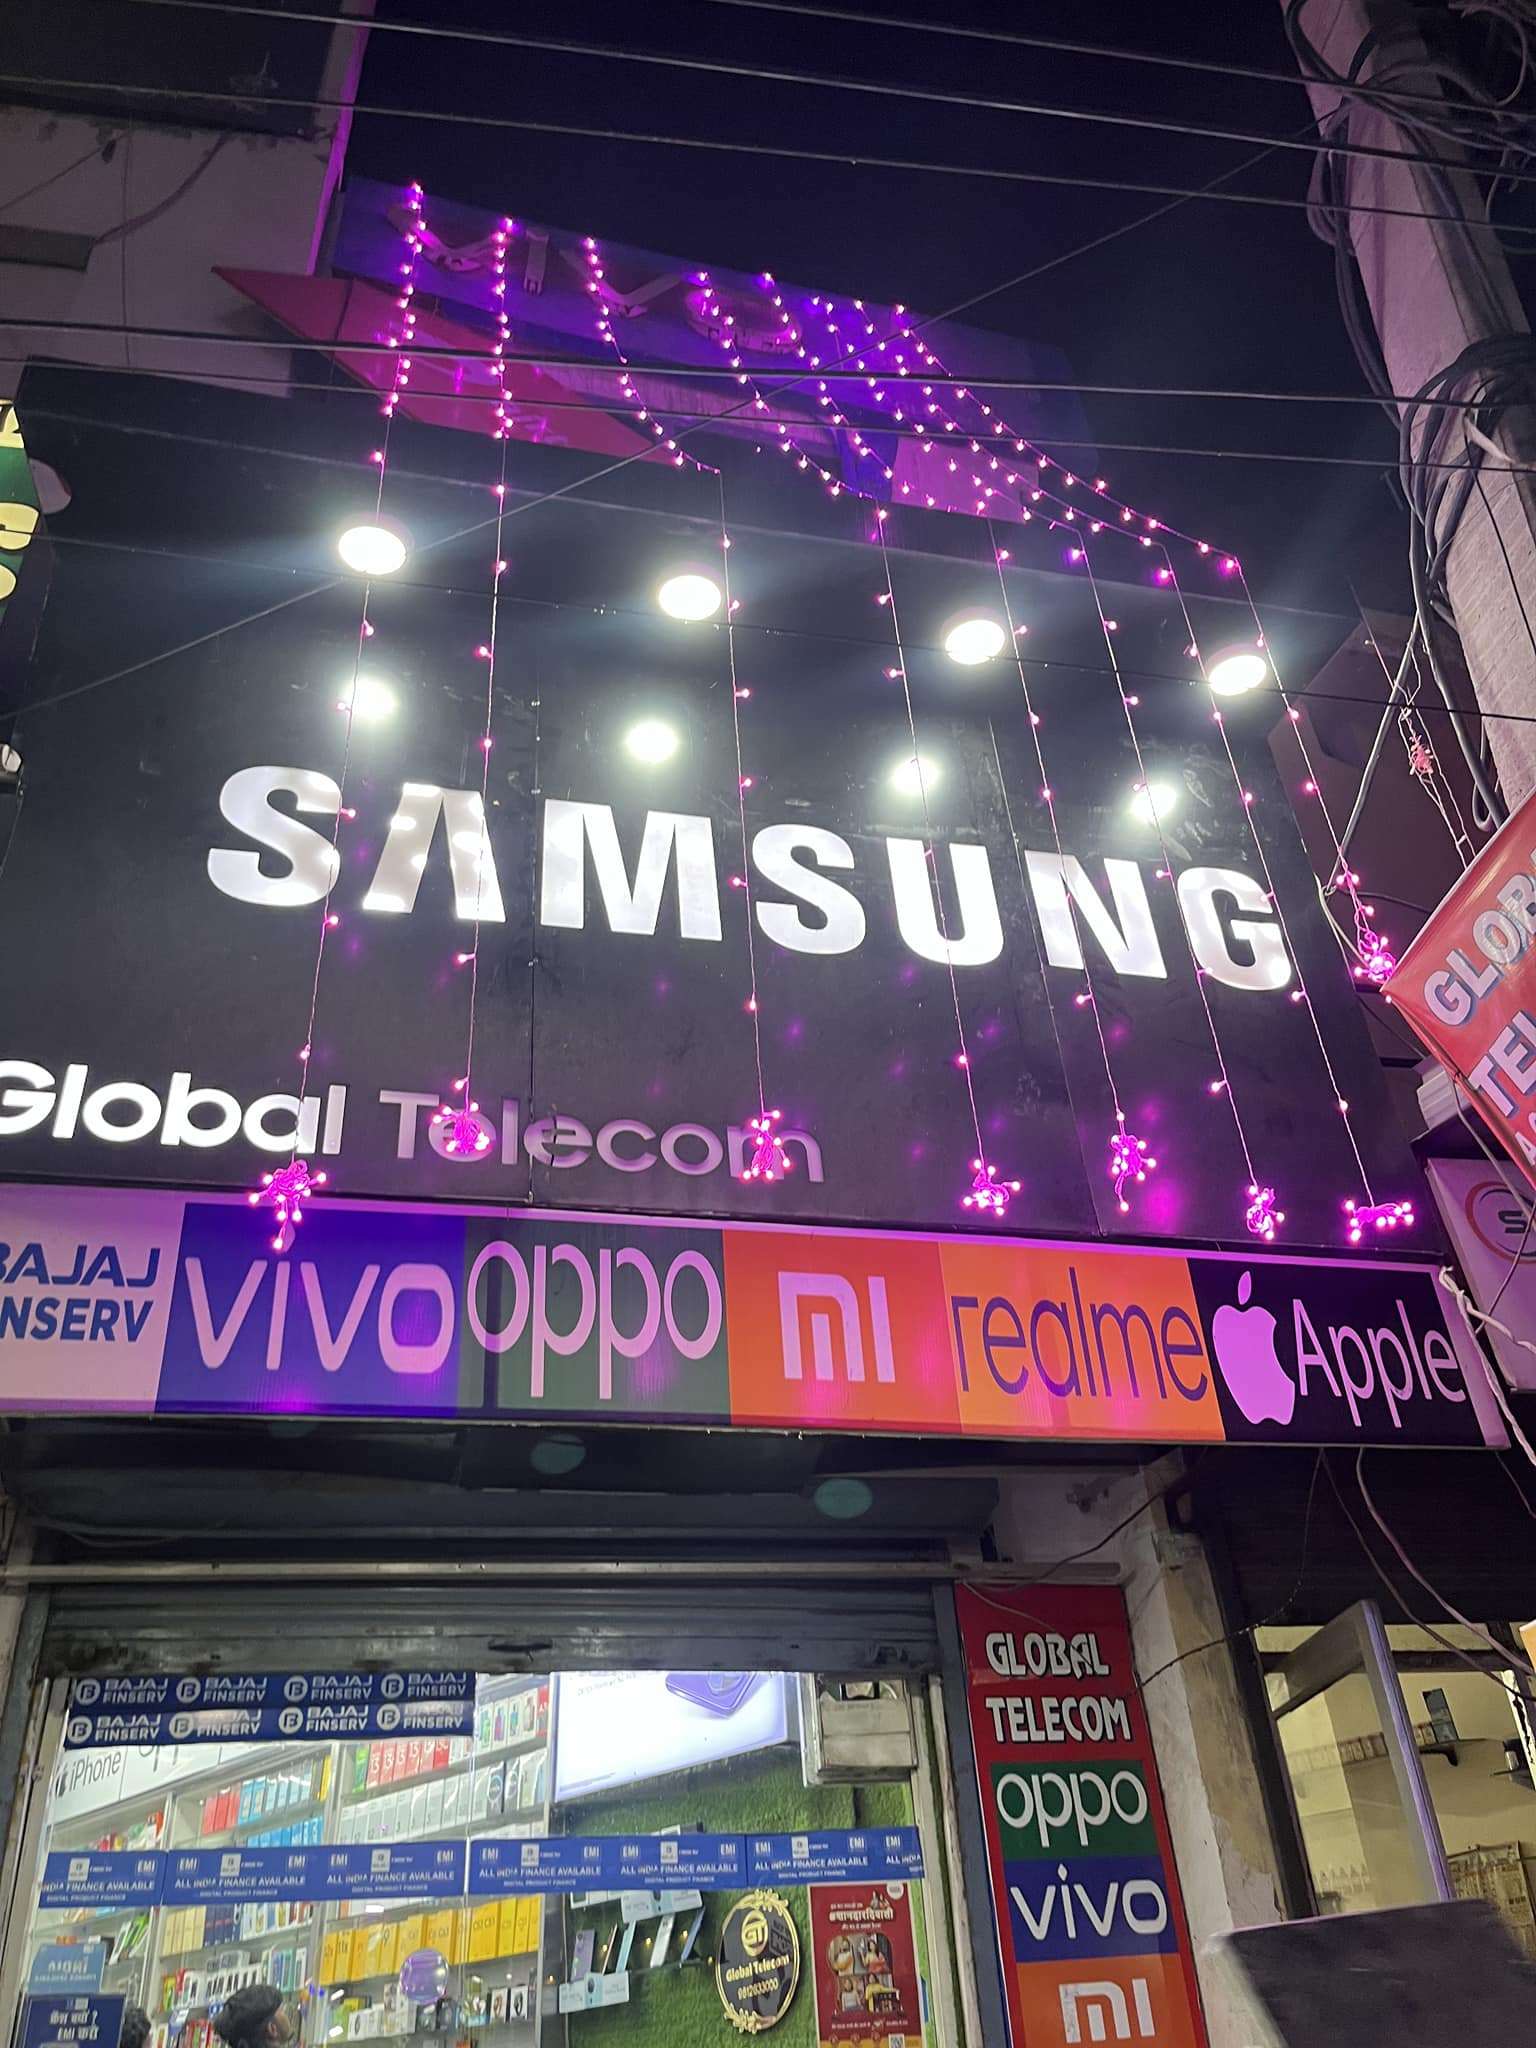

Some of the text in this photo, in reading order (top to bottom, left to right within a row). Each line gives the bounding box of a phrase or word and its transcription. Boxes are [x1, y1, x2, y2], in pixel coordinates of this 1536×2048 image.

[207, 765, 1293, 991] SAMSUNG
[1424, 848, 1536, 1027] GLOB
[0, 1058, 825, 1183] Global Telecom
[467, 1240, 722, 1399] oppo
[950, 1266, 1209, 1402] realme
[1293, 1298, 1466, 1428] Apple
[985, 1632, 1109, 1679] GLOBAL
[105, 1678, 169, 1690] BAJAJ
[205, 1676, 268, 1689] BAJAJ
[312, 1675, 373, 1688] BAJAJ
[408, 1672, 467, 1684] BAJAJ
[102, 1689, 167, 1704] FINSERV
[203, 1689, 266, 1703] FINSERV
[311, 1687, 372, 1701] FINSERV
[407, 1685, 466, 1698] FINSERV
[307, 1704, 369, 1718] BAJAJ
[97, 1714, 161, 1729] BAJAJ
[305, 1718, 368, 1732] FINSERV
[403, 1715, 464, 1729] FINSERV
[985, 1696, 1131, 1742] TELECOM
[95, 1725, 161, 1742] FINSERV
[69, 1751, 122, 1793] iPhone
[754, 1861, 770, 1871] ALL
[792, 1858, 827, 1868] FINANCE
[826, 1856, 869, 1867] AVAILABLE
[885, 1855, 901, 1865] ALL
[479, 1868, 496, 1878] ALL
[520, 1867, 558, 1877] FINANCE
[557, 1865, 601, 1876] AVAILABLE
[620, 1865, 636, 1875] ALL
[660, 1864, 695, 1874] FINANCE
[695, 1863, 738, 1873] AVAILABLE
[175, 1879, 191, 1889] ALL
[218, 1877, 257, 1888] FINANCE
[258, 1876, 306, 1886] AVAILABLE
[326, 1874, 343, 1885] ALL
[369, 1872, 407, 1883] FINANCE
[408, 1871, 455, 1881] AVAILABLE
[66, 1881, 104, 1892] FINANCE
[106, 1880, 155, 1890] AVAILABLE
[1010, 1863, 1168, 1941] vivo
[726, 1954, 790, 1982] Global Telecom
